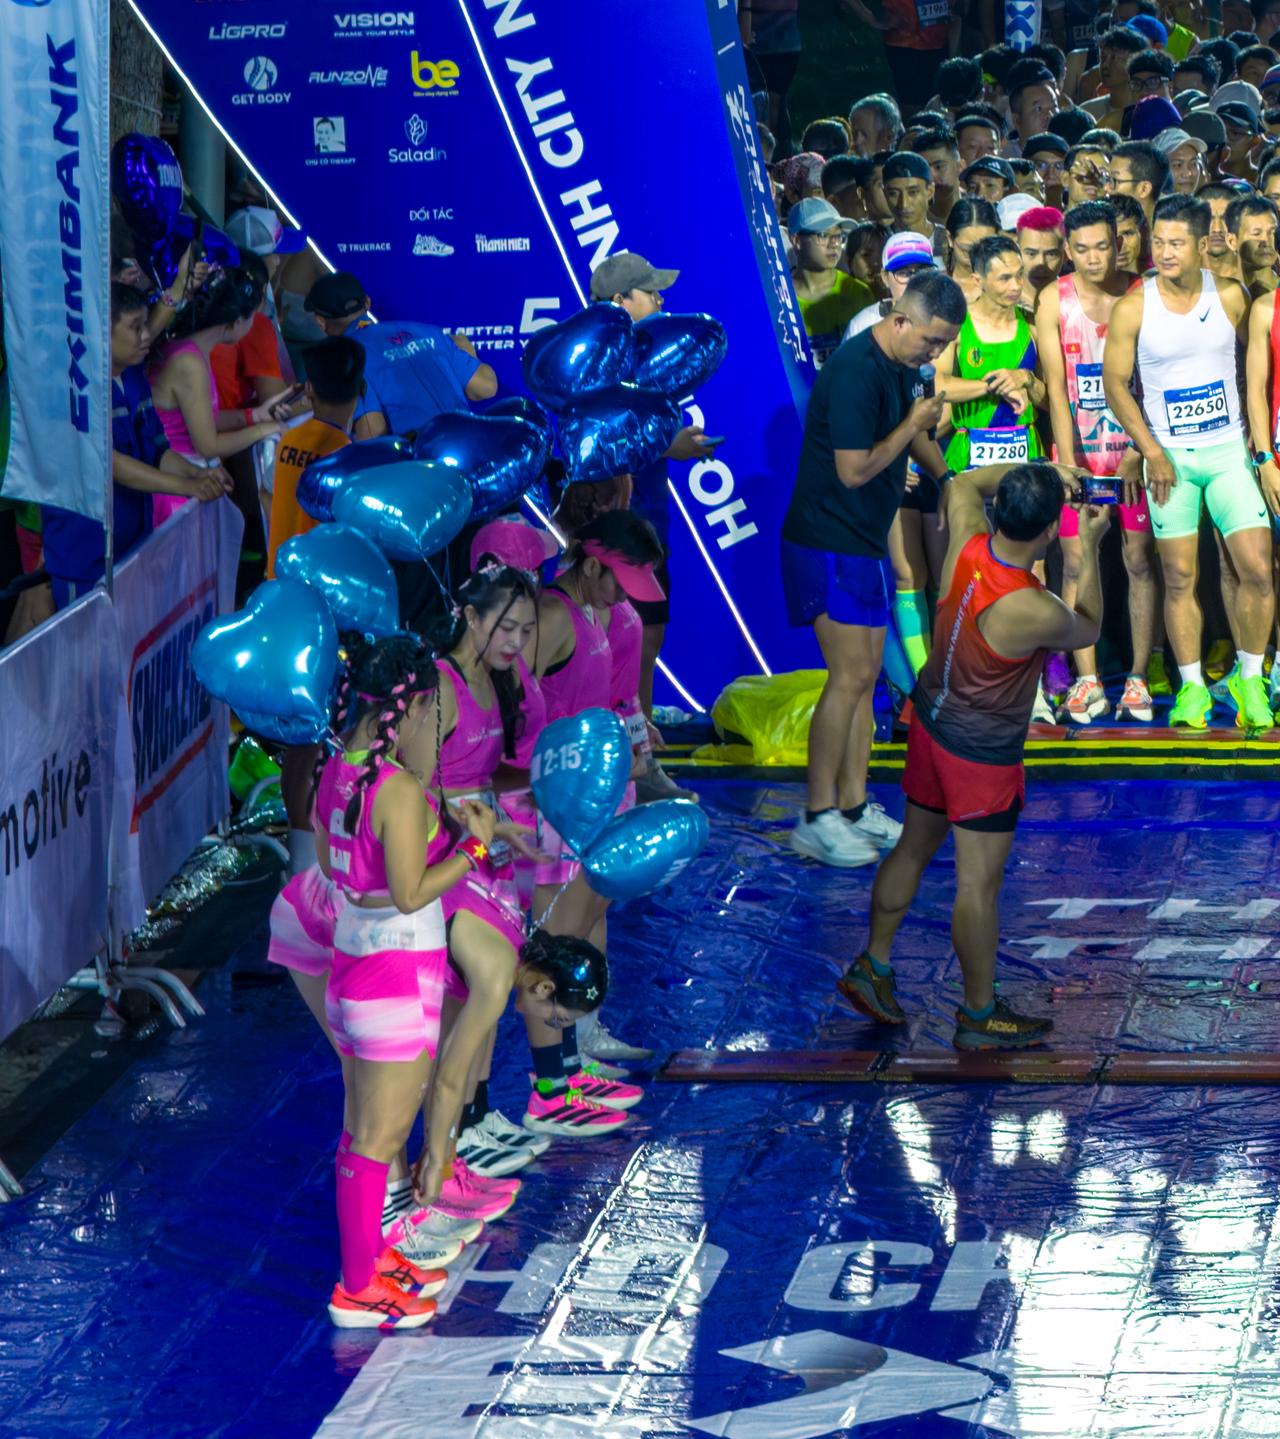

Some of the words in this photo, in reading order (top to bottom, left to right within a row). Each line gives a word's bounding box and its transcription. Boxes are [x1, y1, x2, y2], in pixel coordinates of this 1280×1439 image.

[334, 12, 414, 28] VISION
[411, 50, 460, 90] be
[232, 94, 254, 105] GET
[258, 93, 292, 104] BODY
[504, 55, 585, 169] CITY
[388, 147, 447, 163] Saladin
[45, 32, 90, 435] EXIMBANK
[1172, 397, 1225, 419] 22650
[975, 444, 1027, 460] 21280
